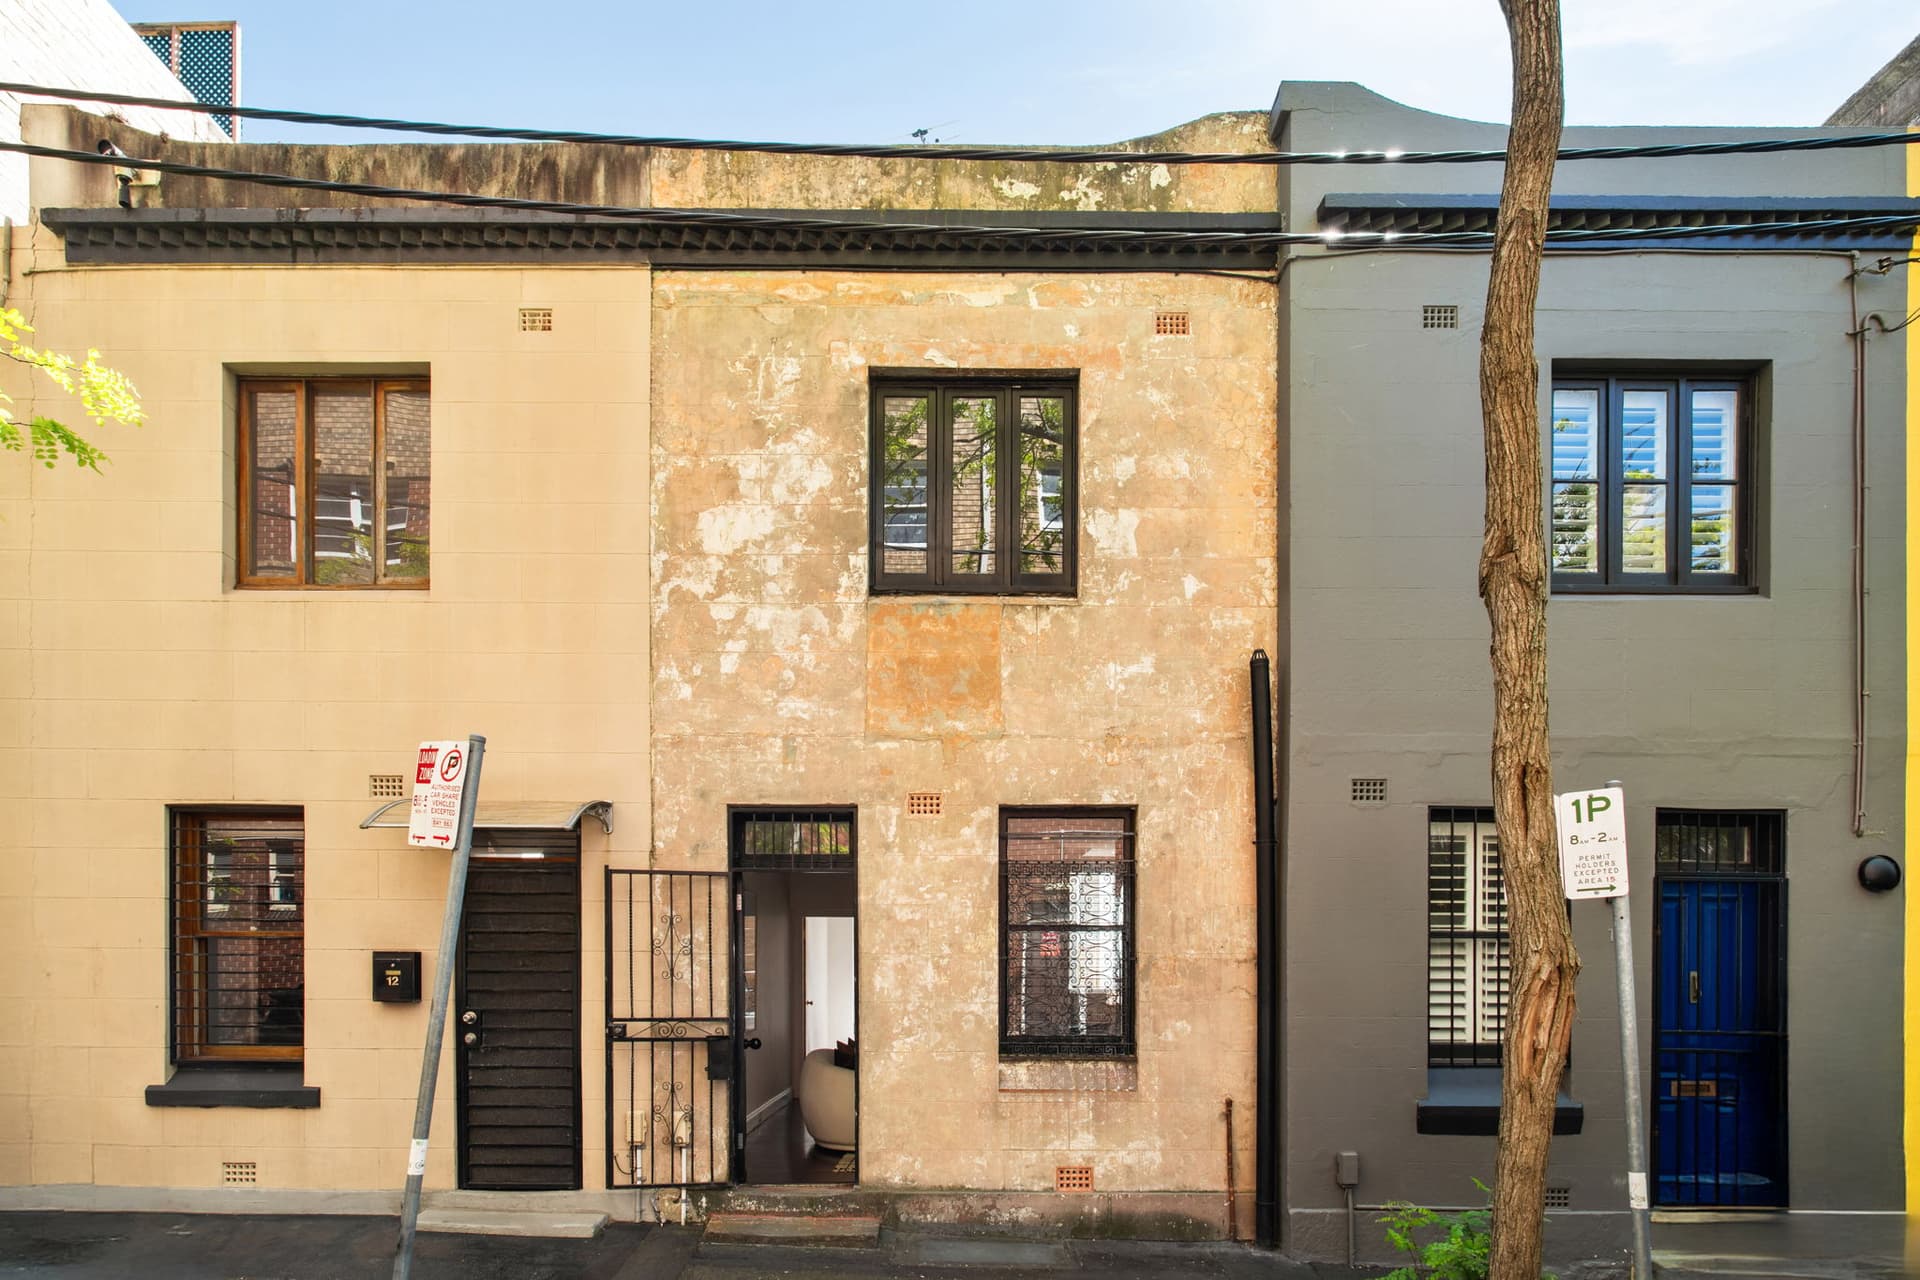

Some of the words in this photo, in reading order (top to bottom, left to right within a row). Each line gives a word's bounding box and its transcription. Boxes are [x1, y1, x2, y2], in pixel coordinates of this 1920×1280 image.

[418, 751, 437, 764] LOADIN
[442, 792, 460, 800] SHARE
[431, 807, 456, 816] EXCEPTED
[1571, 796, 1611, 824] 1P
[1579, 853, 1610, 861] PERMIT
[1575, 860, 1616, 869] HOLDERS
[1574, 867, 1619, 877] EXCEPTED
[1578, 877, 1603, 885] AREA
[386, 976, 400, 986] 12
